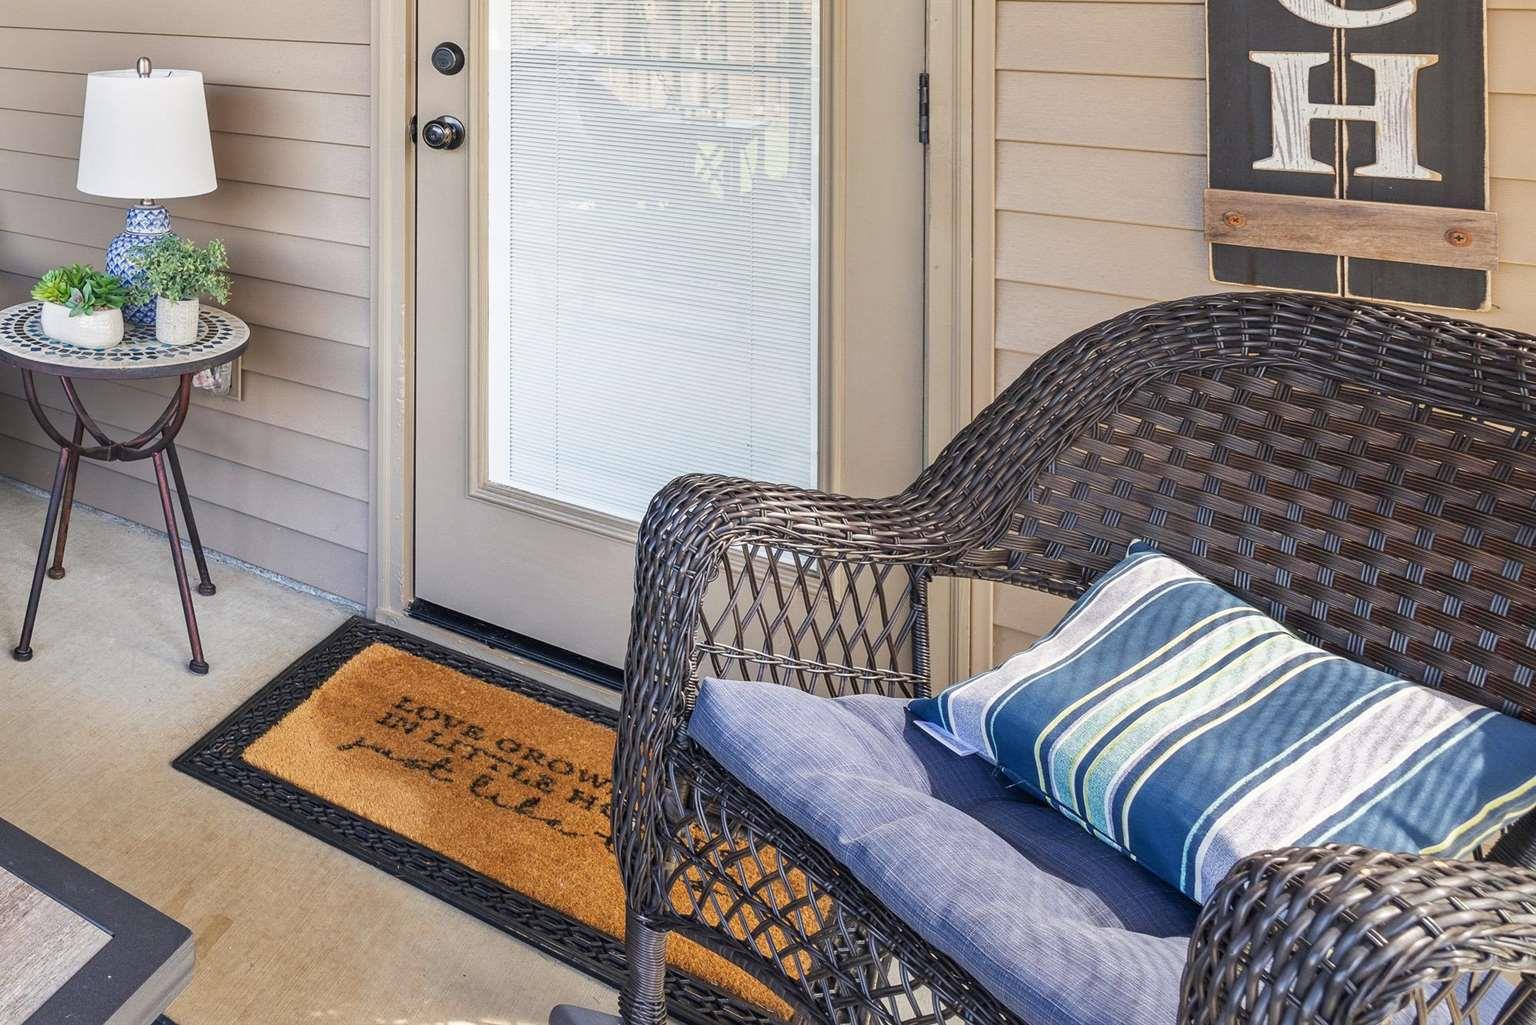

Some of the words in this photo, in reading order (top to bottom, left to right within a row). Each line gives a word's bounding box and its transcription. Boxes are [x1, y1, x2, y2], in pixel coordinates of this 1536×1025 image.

[376, 712, 420, 734] IN
[424, 729, 556, 794] LITTLE
[392, 695, 486, 741] LOVE
[495, 737, 613, 789] GROW
